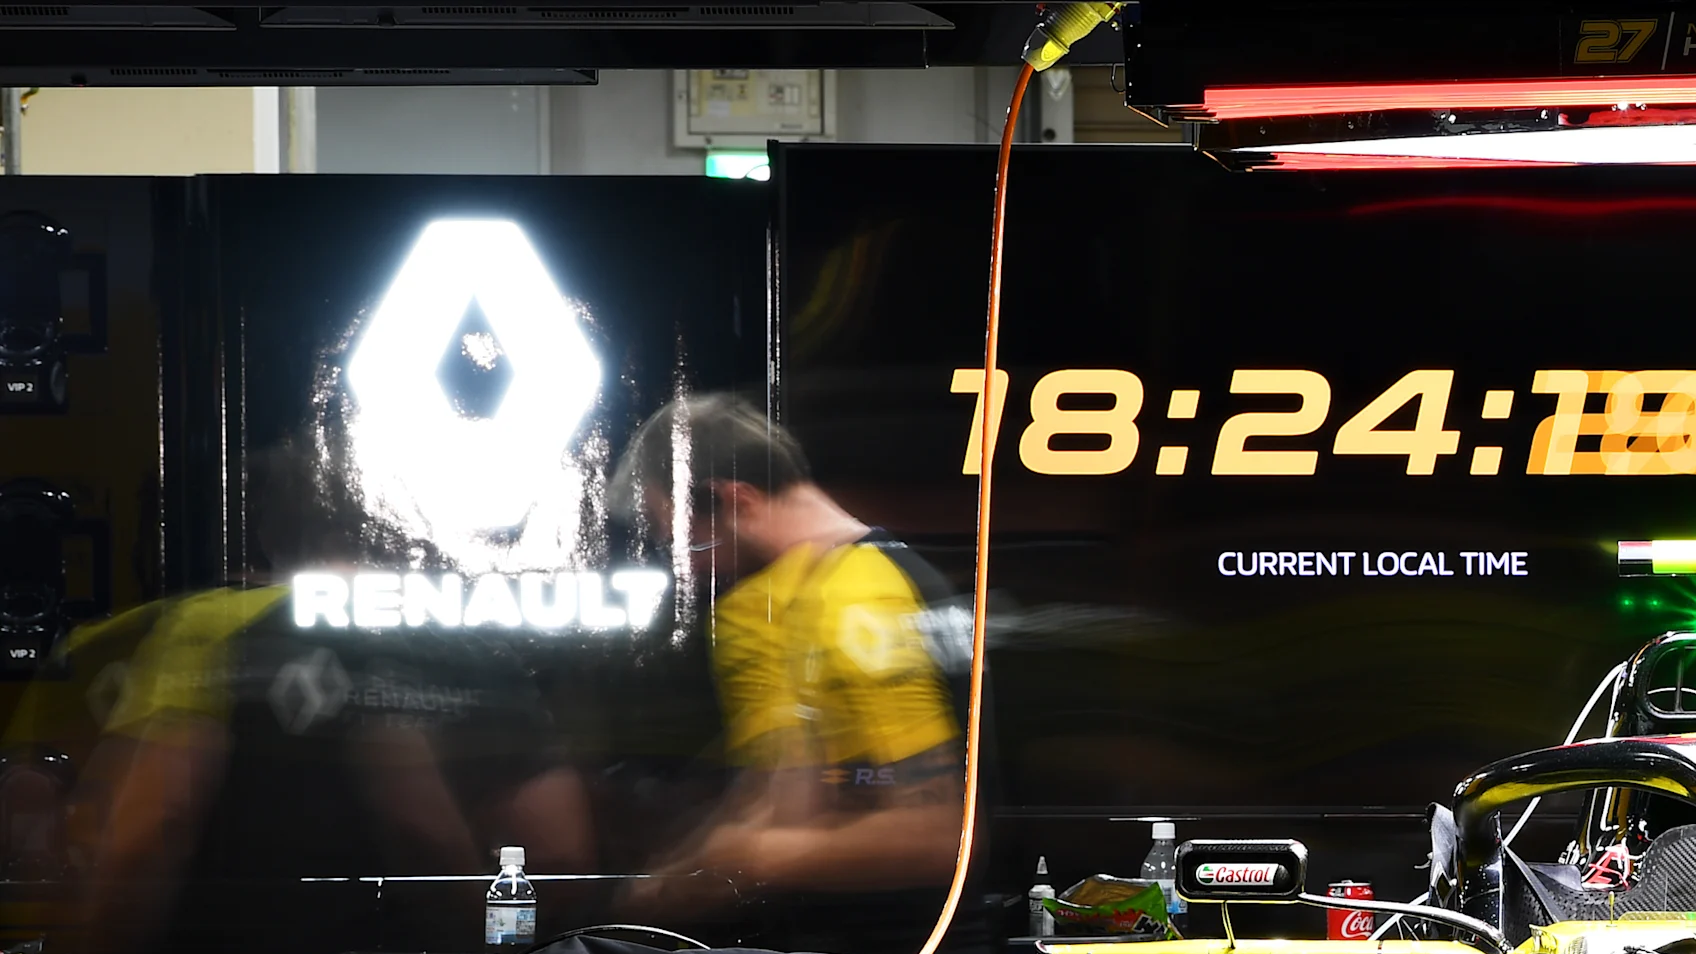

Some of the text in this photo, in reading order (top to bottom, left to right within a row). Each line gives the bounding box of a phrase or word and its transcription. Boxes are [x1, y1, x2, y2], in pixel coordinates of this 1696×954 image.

[1574, 18, 1658, 64] 27
[7, 382, 34, 392] VIP 2
[1218, 552, 1528, 576] CURRENT LOCAL TIME
[292, 571, 668, 628] RENAULT
[10, 649, 36, 658] VIP 2
[855, 767, 897, 786] R.S.
[1215, 866, 1270, 883] Castrol
